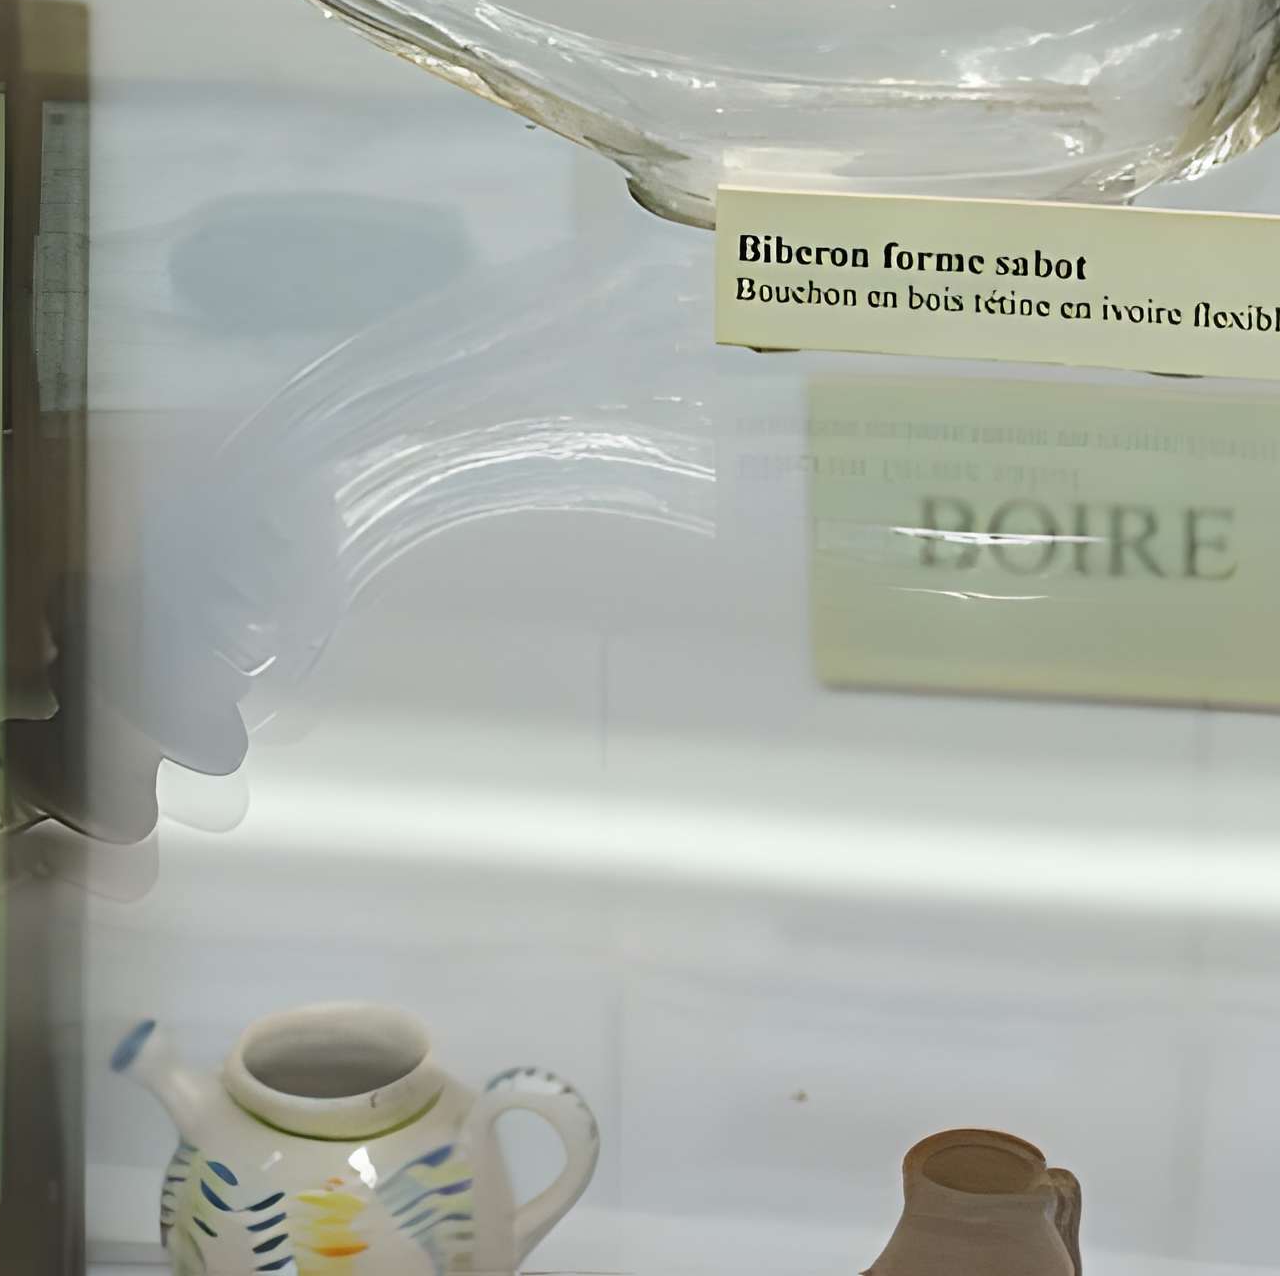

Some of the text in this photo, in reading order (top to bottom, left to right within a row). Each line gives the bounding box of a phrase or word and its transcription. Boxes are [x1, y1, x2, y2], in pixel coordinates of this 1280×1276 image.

[738, 234, 1088, 281] Biberon forme sabot
[736, 277, 858, 307] Bouchon
[867, 290, 898, 310] en
[908, 285, 965, 313] bois
[1059, 301, 1092, 320] en
[1102, 295, 1183, 325] ivoire
[919, 495, 1239, 582] BOIRE
